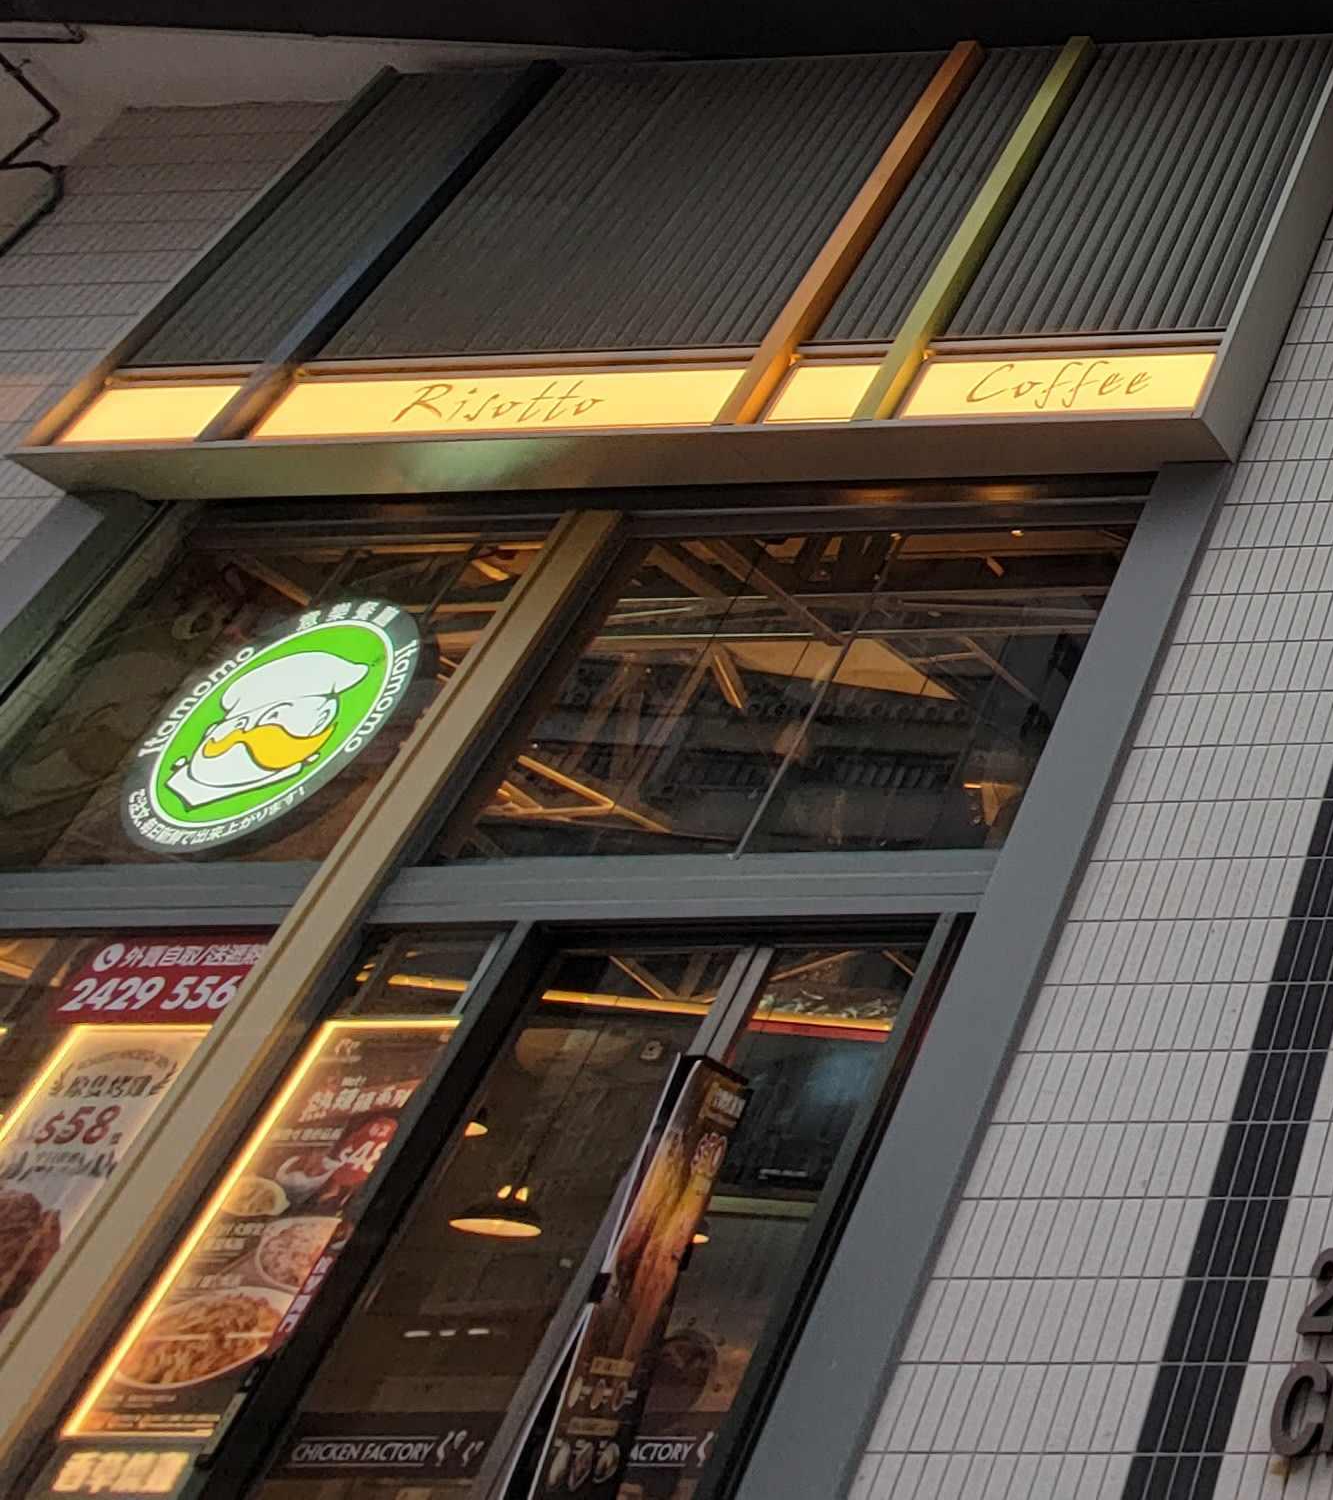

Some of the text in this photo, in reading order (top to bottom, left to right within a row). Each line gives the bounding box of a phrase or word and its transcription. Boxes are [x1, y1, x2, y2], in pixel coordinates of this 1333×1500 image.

[392, 380, 606, 423] Risotto
[966, 360, 1154, 409] Coffee
[138, 645, 256, 758] Itamomo
[342, 638, 418, 753] Itamomo
[58, 977, 166, 1011] 2429
[34, 1105, 122, 1145] $58
[292, 1441, 432, 1462] CHICKEN FACTORY
